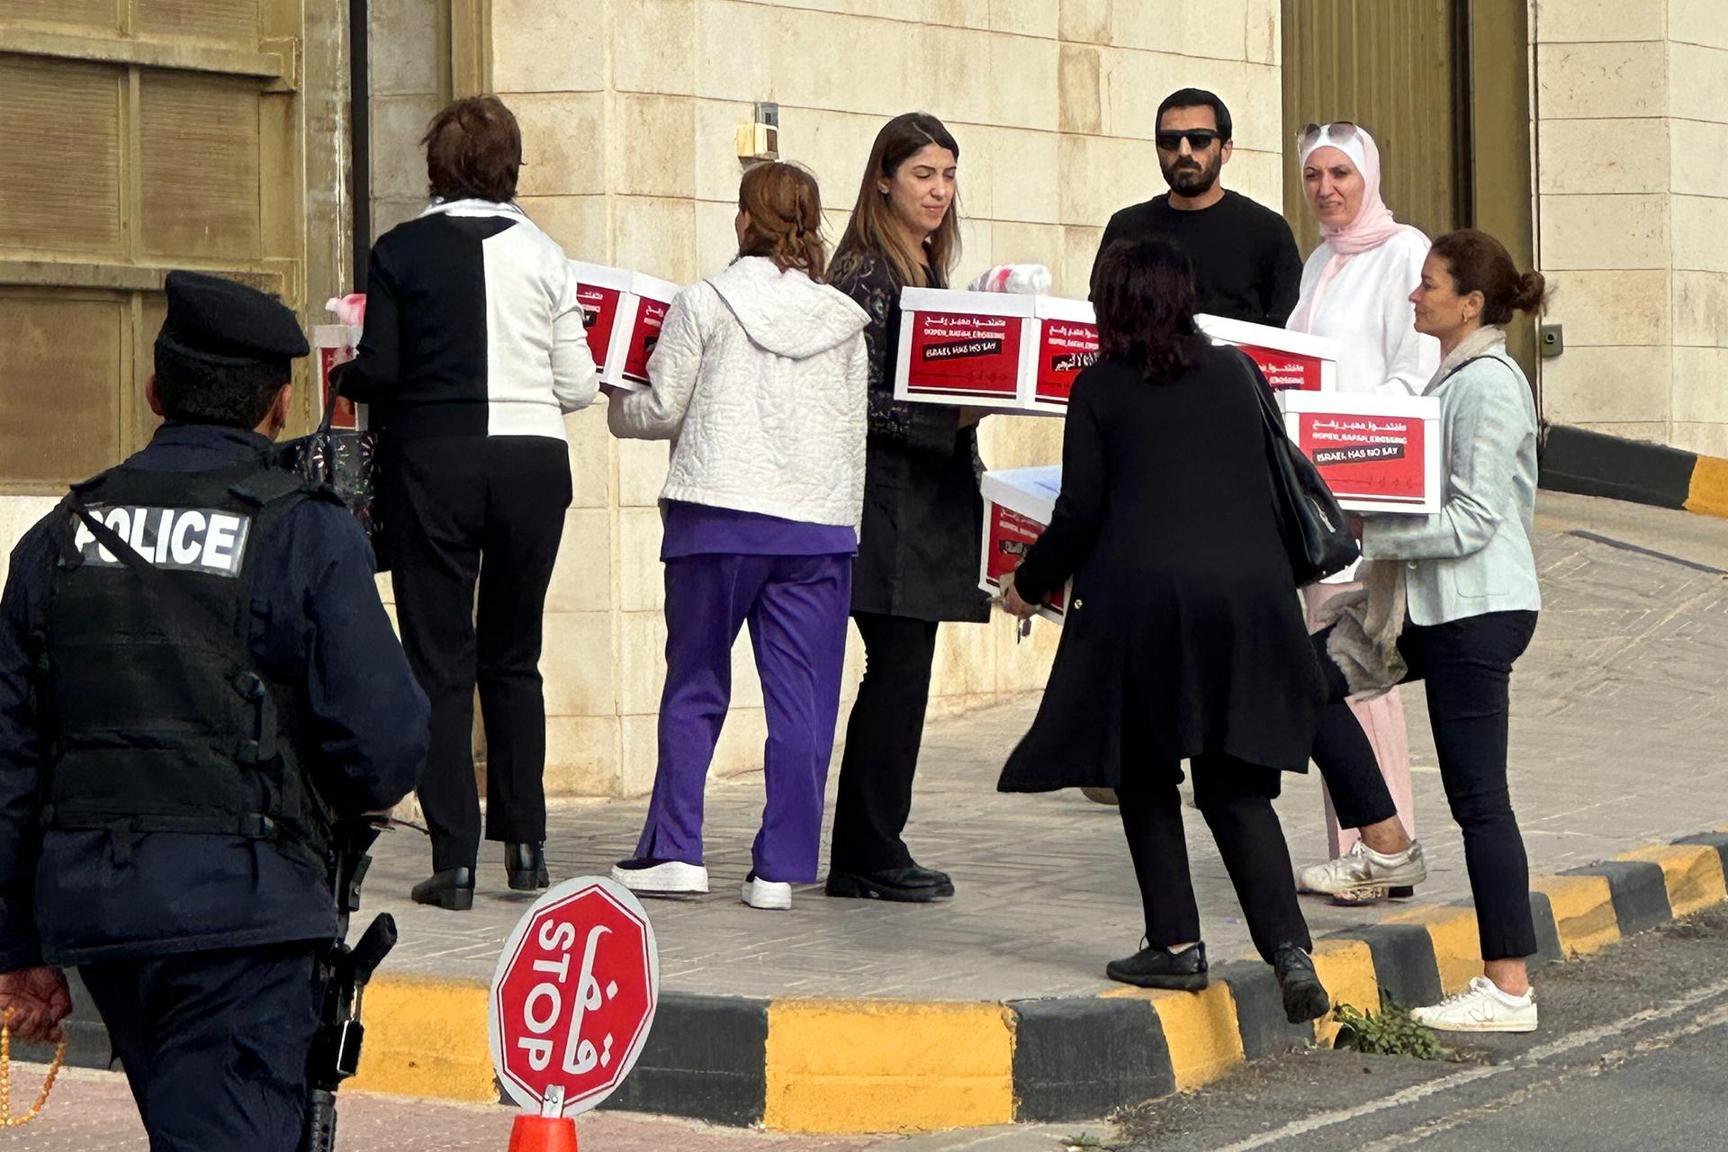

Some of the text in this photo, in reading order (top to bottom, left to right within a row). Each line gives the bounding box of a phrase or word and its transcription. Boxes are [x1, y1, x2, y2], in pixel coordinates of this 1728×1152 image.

[1316, 447, 1399, 462] ISRAEL HAS NO SAY
[75, 507, 240, 569] POLICE
[518, 919, 576, 1072] STOP
[562, 924, 619, 1075] قف
